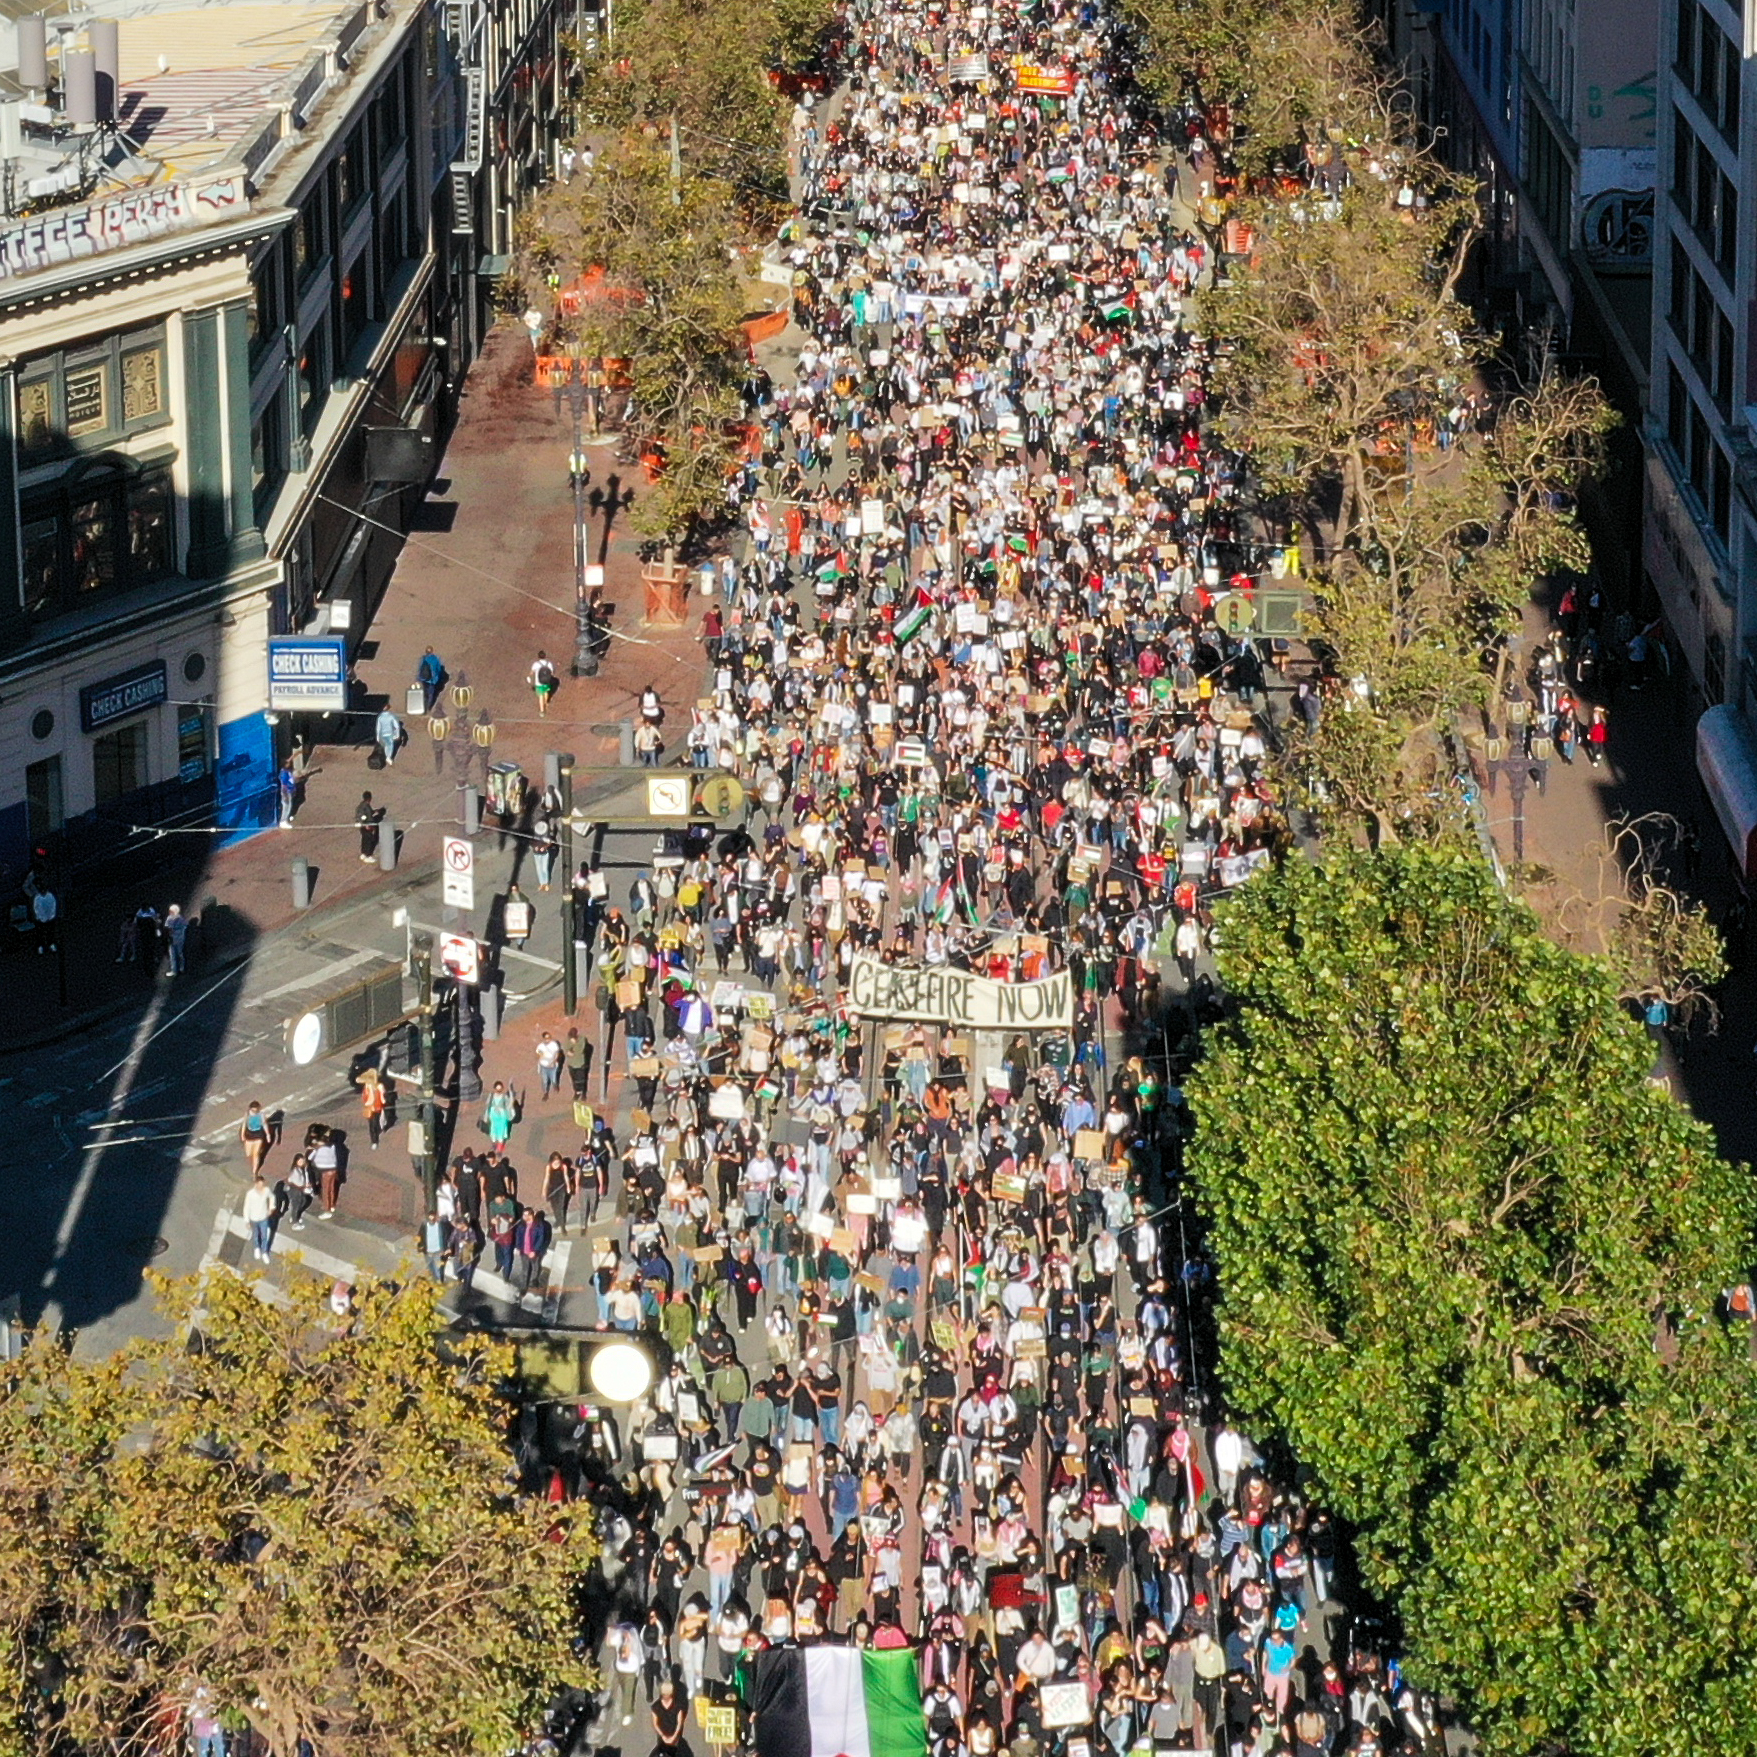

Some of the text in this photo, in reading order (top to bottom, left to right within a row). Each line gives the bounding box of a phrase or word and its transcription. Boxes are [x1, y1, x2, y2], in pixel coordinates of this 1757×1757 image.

[273, 654, 339, 673] CHECK CASHING
[91, 676, 164, 720] CHECK CASHING
[274, 686, 338, 694] PAYROLL ADVANCE
[997, 974, 1068, 1023] NOW
